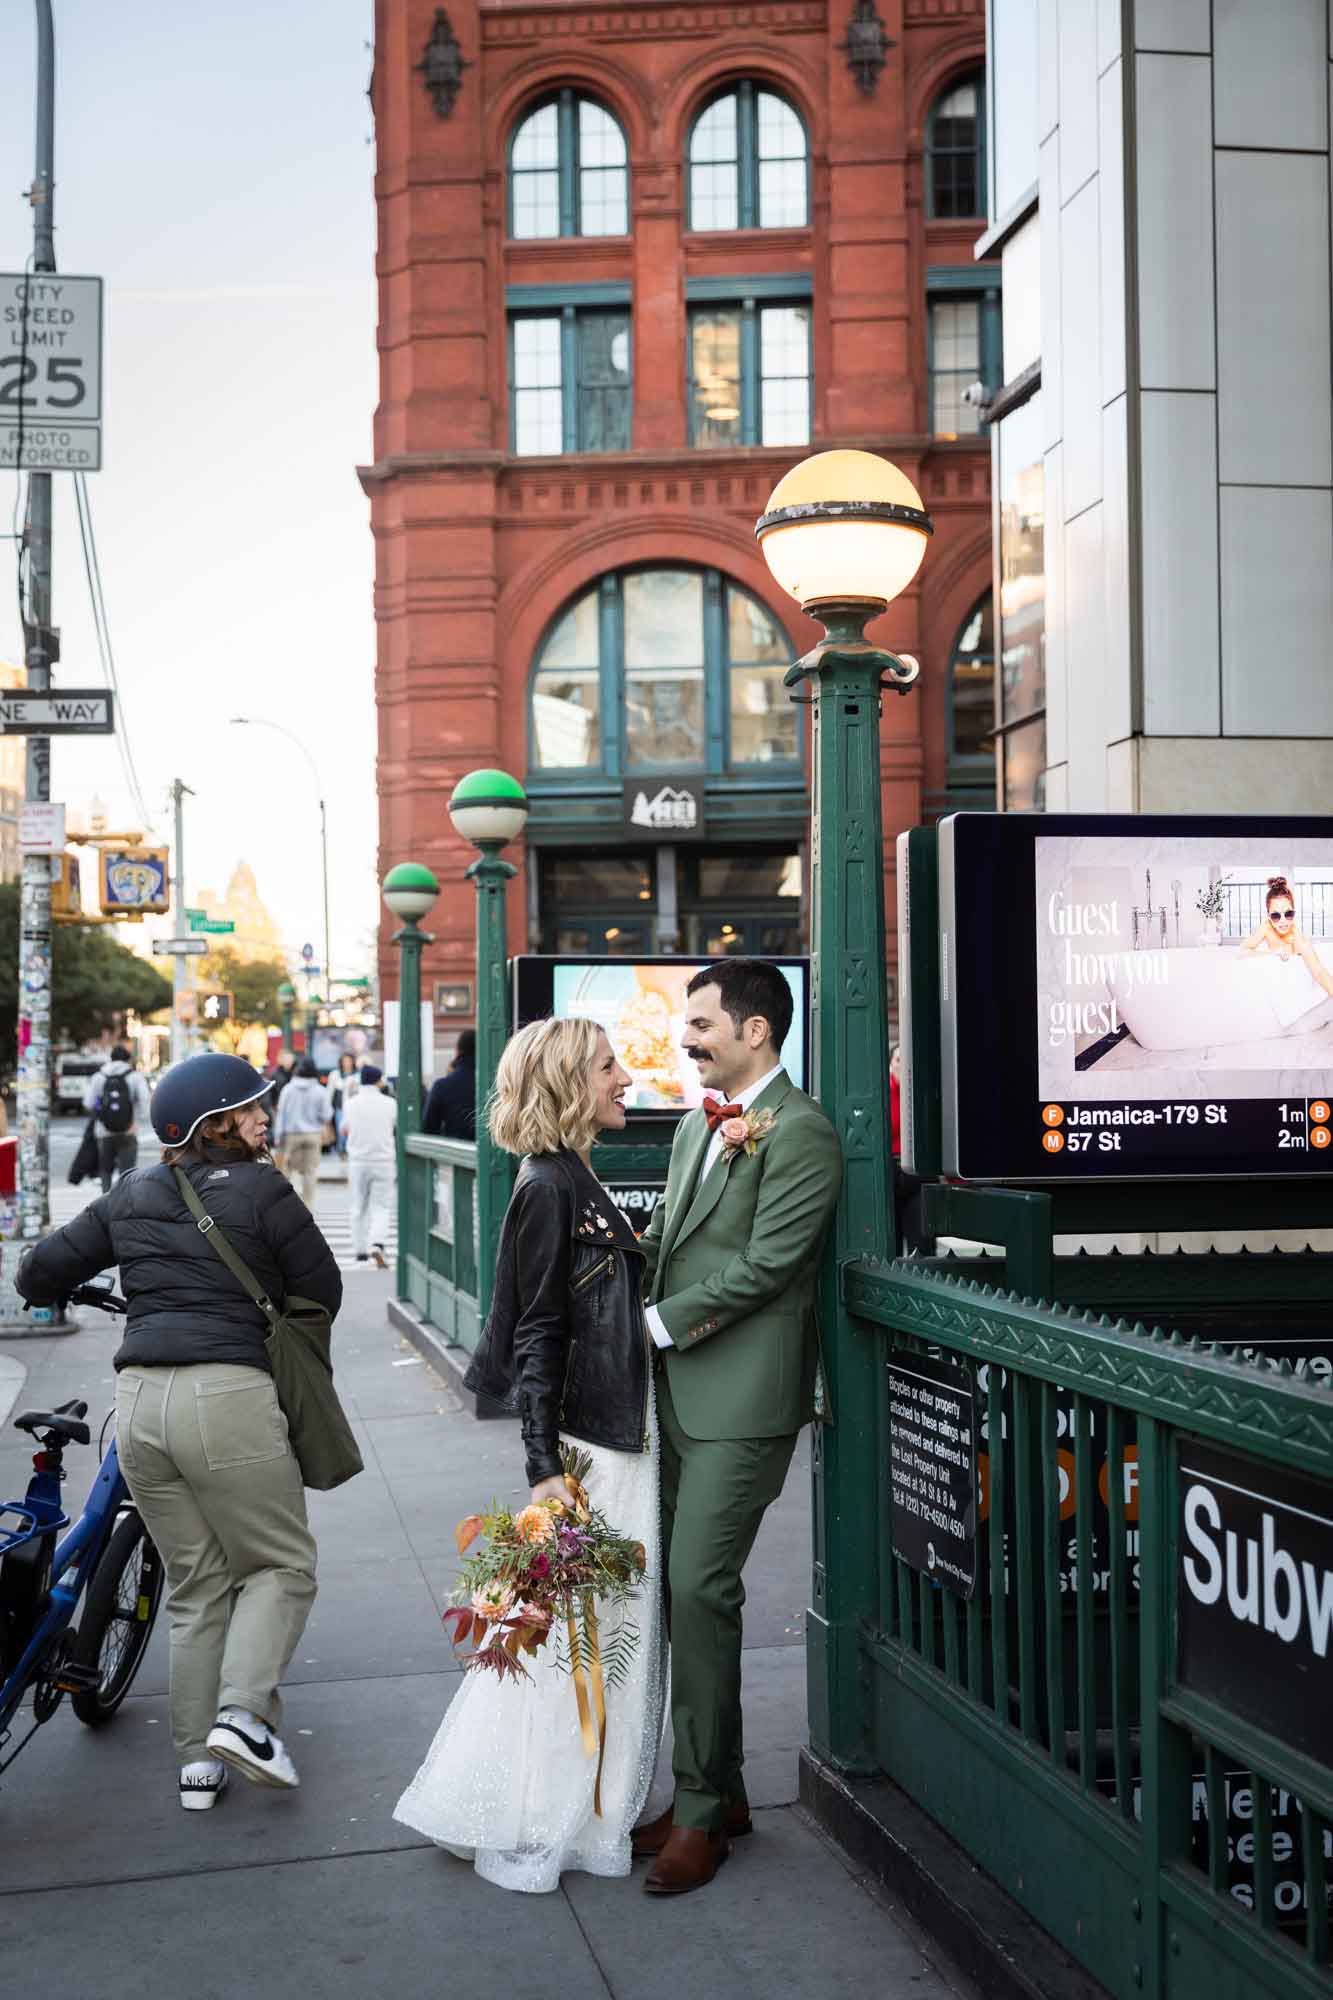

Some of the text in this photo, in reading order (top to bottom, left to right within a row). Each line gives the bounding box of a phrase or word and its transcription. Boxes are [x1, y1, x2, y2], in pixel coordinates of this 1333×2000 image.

[14, 284, 63, 301] CITY
[4, 307, 75, 325] SPEED
[11, 331, 68, 347] LIMIT
[0, 355, 86, 408] 25
[8, 431, 71, 447] PHOTO
[1, 448, 90, 464] NORCED
[0, 703, 100, 720] NE WAY
[1049, 891, 1120, 936] Guest
[1065, 939, 1168, 998] how you
[1049, 1000, 1121, 1046] guest
[1067, 1105, 1199, 1125] Jamaica-179
[1204, 1104, 1227, 1123] St
[1278, 1104, 1304, 1123] 1m
[1067, 1133, 1093, 1151] 57
[1098, 1132, 1121, 1150] St
[1278, 1130, 1304, 1148] 2m
[604, 1186, 658, 1212] way
[889, 1375, 960, 1420] Bicycles or other property
[889, 1400, 913, 1421] attached
[913, 1408, 920, 1424] to
[921, 1411, 937, 1432] these
[938, 1420, 958, 1443] railings
[959, 1428, 970, 1446] will
[890, 1419, 969, 1470] be removed and delivered to
[891, 1442, 950, 1485] the Lost Property Unit
[891, 1463, 911, 1488] located
[911, 1476, 918, 1492] at
[919, 1478, 927, 1497] 34
[928, 1482, 935, 1501] St
[936, 1487, 941, 1505] &
[949, 1494, 957, 1512] Av
[905, 1492, 919, 1517] (212)
[1183, 1484, 1333, 1660] Subw
[186, 1775, 212, 1786] NIKE
